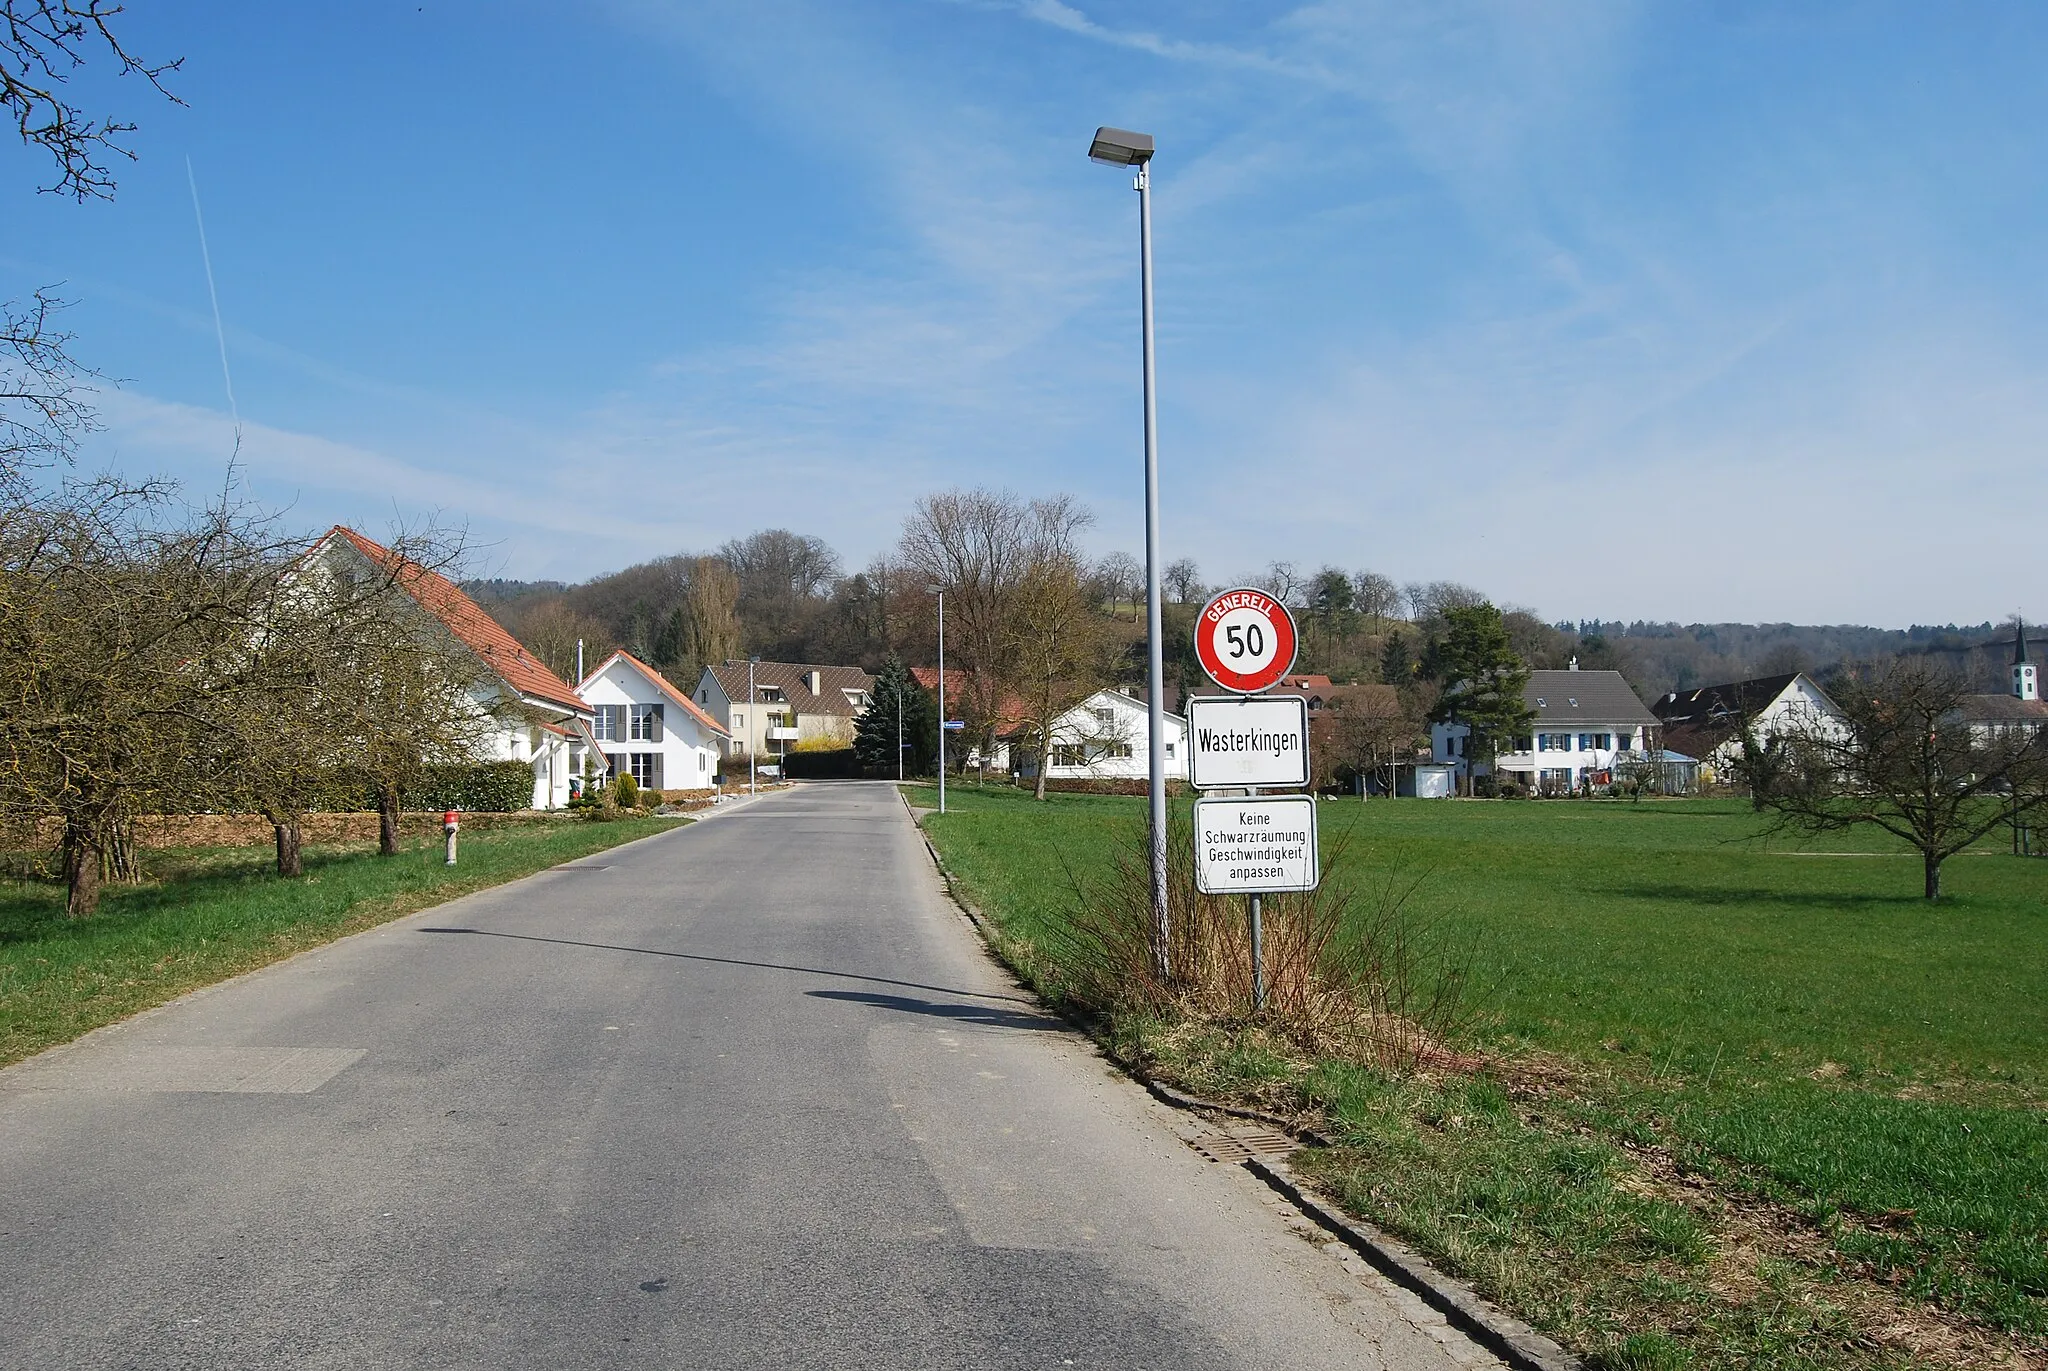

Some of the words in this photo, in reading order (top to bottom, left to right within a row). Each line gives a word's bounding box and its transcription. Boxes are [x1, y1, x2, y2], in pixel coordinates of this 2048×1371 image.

[1206, 594, 1274, 622] GENERELL
[1226, 623, 1264, 659] 50
[1198, 727, 1298, 757] Wasterkingen
[1239, 811, 1271, 826] Keine
[1205, 829, 1306, 845] Schwarzräumung
[1209, 846, 1303, 863] Geschwindigkeit
[1229, 867, 1284, 882] anpassen
